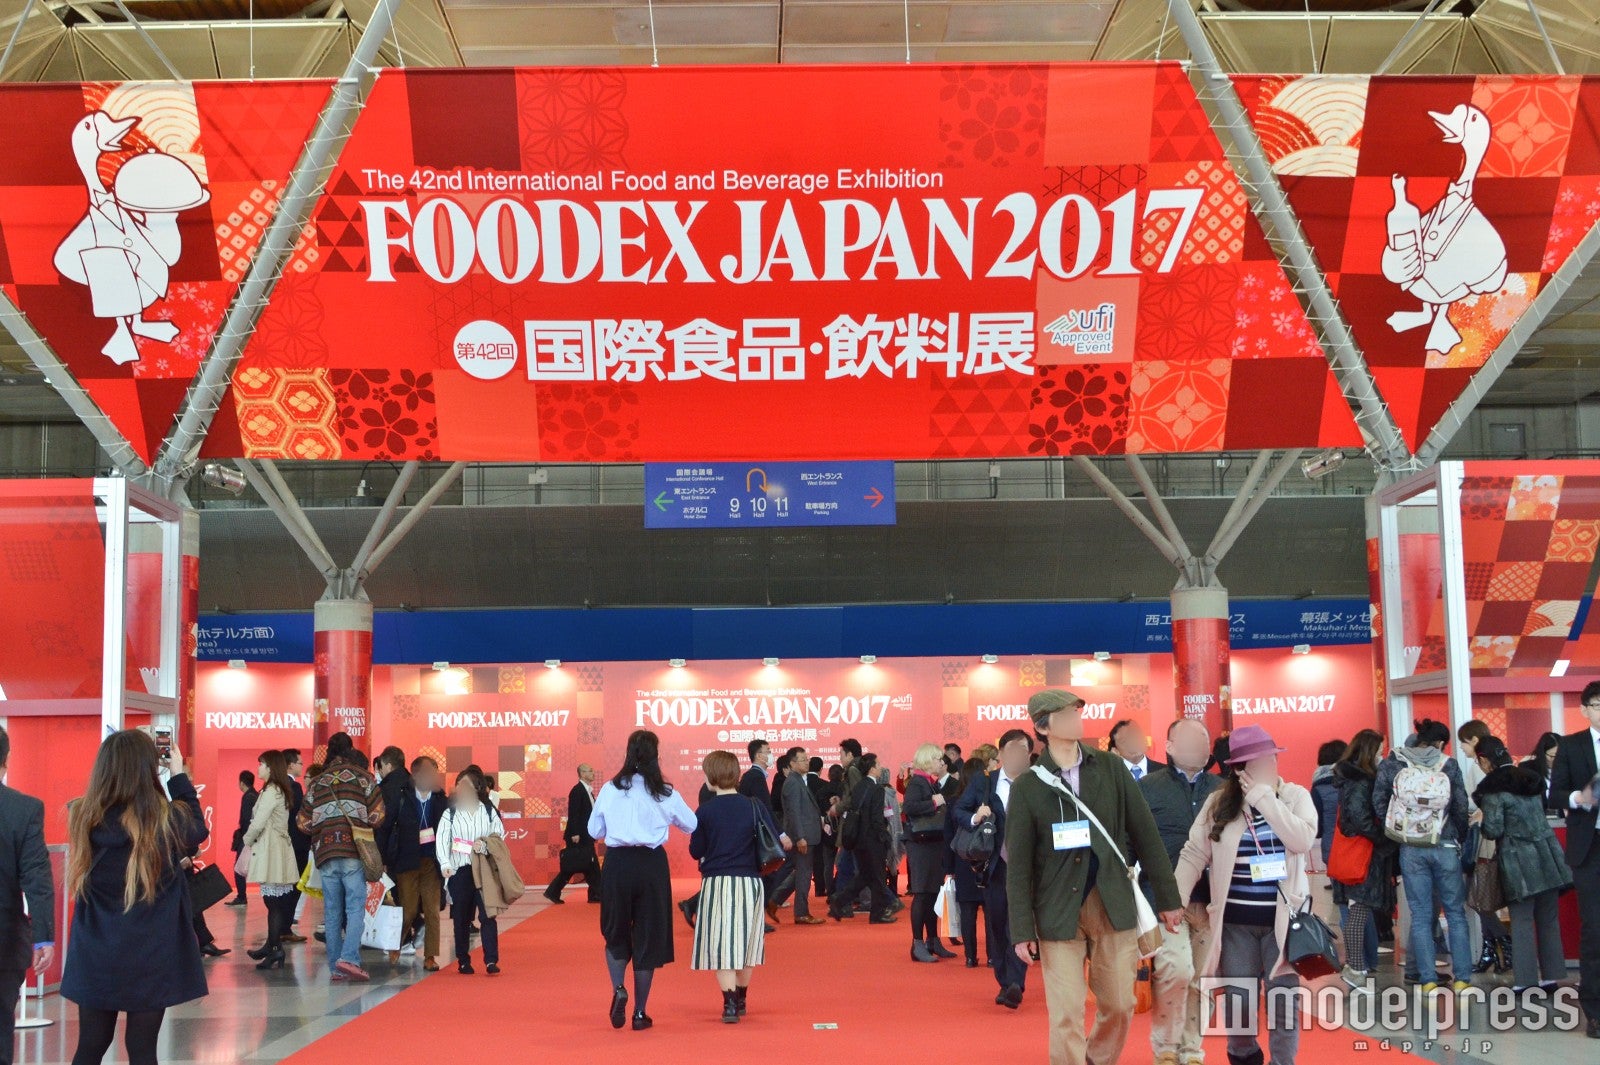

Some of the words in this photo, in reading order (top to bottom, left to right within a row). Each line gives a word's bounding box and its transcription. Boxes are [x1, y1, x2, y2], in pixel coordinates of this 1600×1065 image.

[362, 168, 404, 191] The
[408, 168, 462, 191] 42nd
[467, 169, 603, 192] International
[612, 170, 668, 192] Food
[674, 170, 717, 191] and
[723, 169, 830, 196] Beverage
[838, 168, 944, 191] Exhibition
[361, 198, 713, 285] FOODEX
[719, 197, 983, 285] JAPAN
[985, 188, 1205, 281] 2017
[1078, 304, 1115, 330] ufi
[1052, 330, 1113, 347] Approved
[456, 342, 515, 360] 第42回
[1075, 341, 1113, 353] Event
[674, 487, 717, 495] 東エントランス
[730, 497, 740, 512] 9
[750, 497, 767, 512] 10
[774, 496, 788, 511] 11
[710, 688, 729, 696] Food
[1183, 694, 1215, 704] FOODEX
[635, 697, 742, 726] FOODEX
[742, 696, 823, 726] JAPAN
[823, 695, 891, 725] 2017
[1080, 702, 1117, 719] 2017
[1183, 703, 1207, 714] JAPAN
[1252, 696, 1298, 714] JAPAN
[1297, 694, 1336, 713] 2017
[334, 707, 366, 717] FOODEX
[427, 711, 486, 729] FOODEX
[487, 711, 533, 728] JAPAN
[532, 709, 570, 727] 2017
[205, 711, 266, 729] FOODEX
[266, 711, 311, 729] JAPAN
[342, 717, 366, 726] JAPAN
[346, 726, 366, 737] 2017
